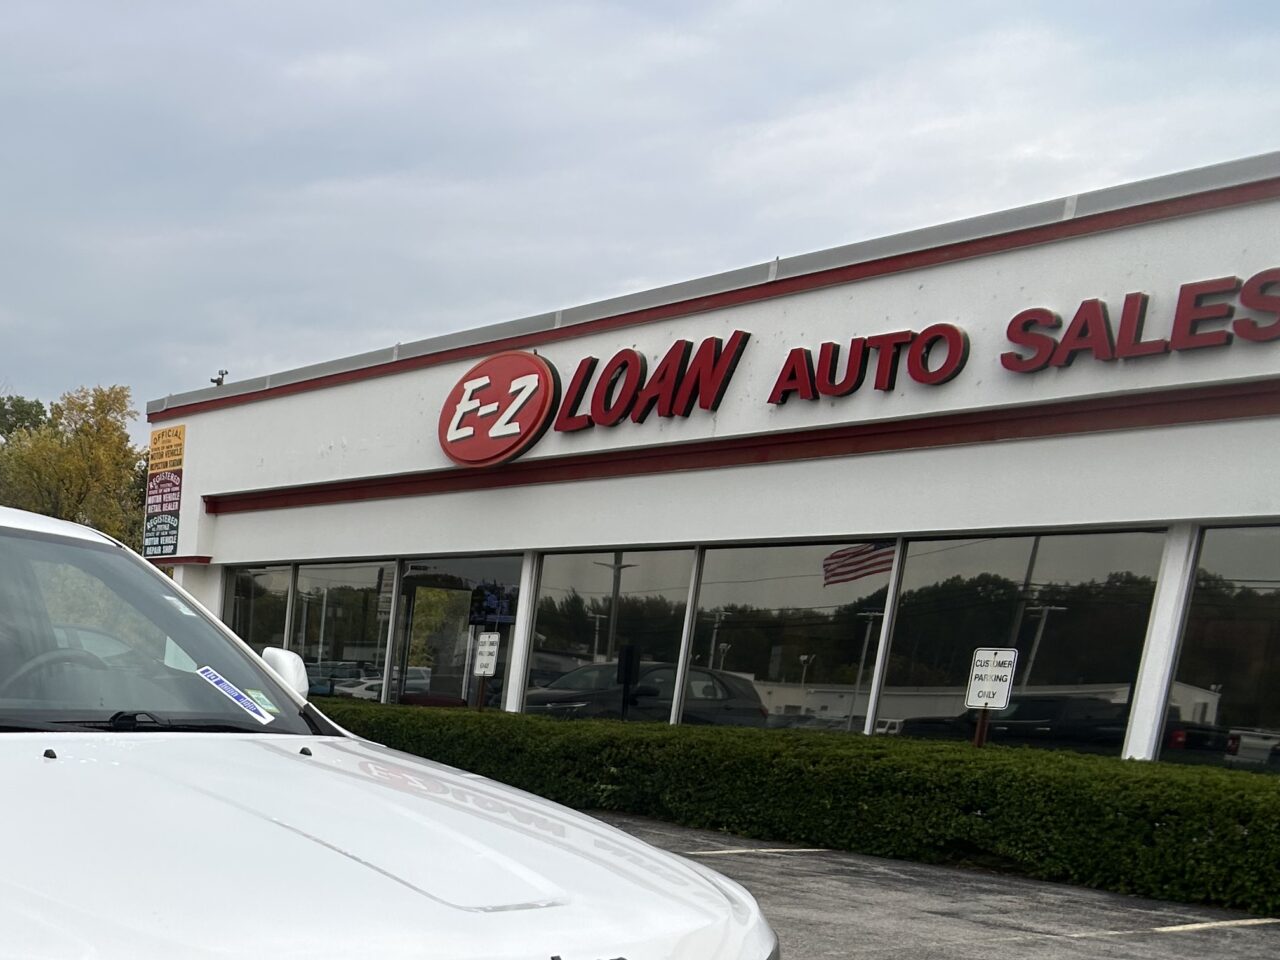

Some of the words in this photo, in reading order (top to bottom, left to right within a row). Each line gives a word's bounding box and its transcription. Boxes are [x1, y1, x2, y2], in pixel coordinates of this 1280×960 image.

[446, 373, 540, 443] E-Z
[553, 329, 753, 433] LOAN
[766, 322, 971, 406] AUTO
[1000, 266, 1280, 375] SALES
[153, 429, 182, 445] OFFICIAL
[149, 471, 180, 490] REGISTERED
[146, 514, 178, 531] REGISTERED
[974, 673, 1009, 683] PARKING
[977, 690, 997, 699] ONLY
